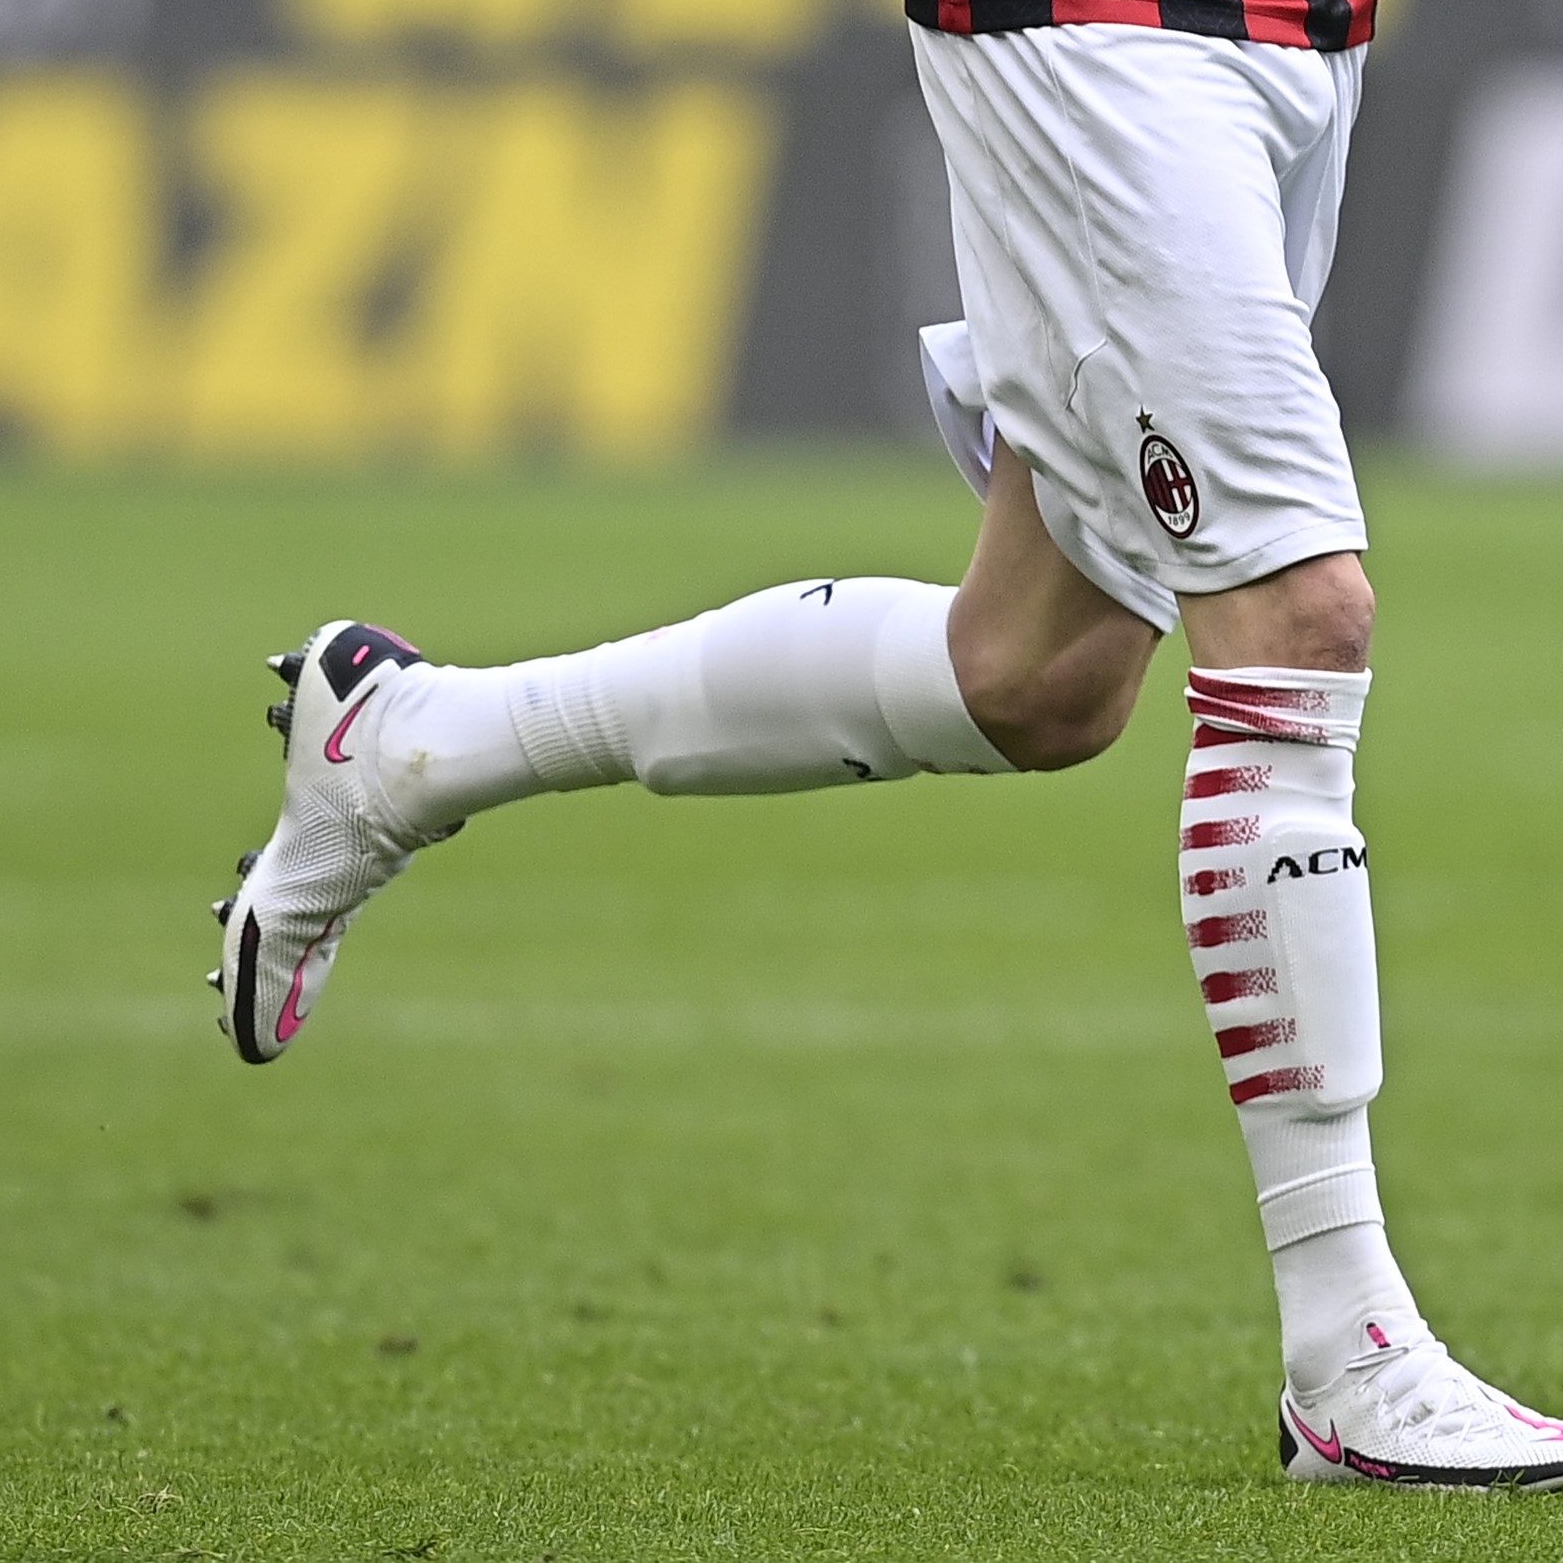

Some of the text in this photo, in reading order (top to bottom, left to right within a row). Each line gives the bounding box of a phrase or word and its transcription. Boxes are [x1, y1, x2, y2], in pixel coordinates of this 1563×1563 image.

[1146, 443, 1174, 466] ACM
[1167, 511, 1191, 527] 1899
[1267, 846, 1368, 886] ACM
